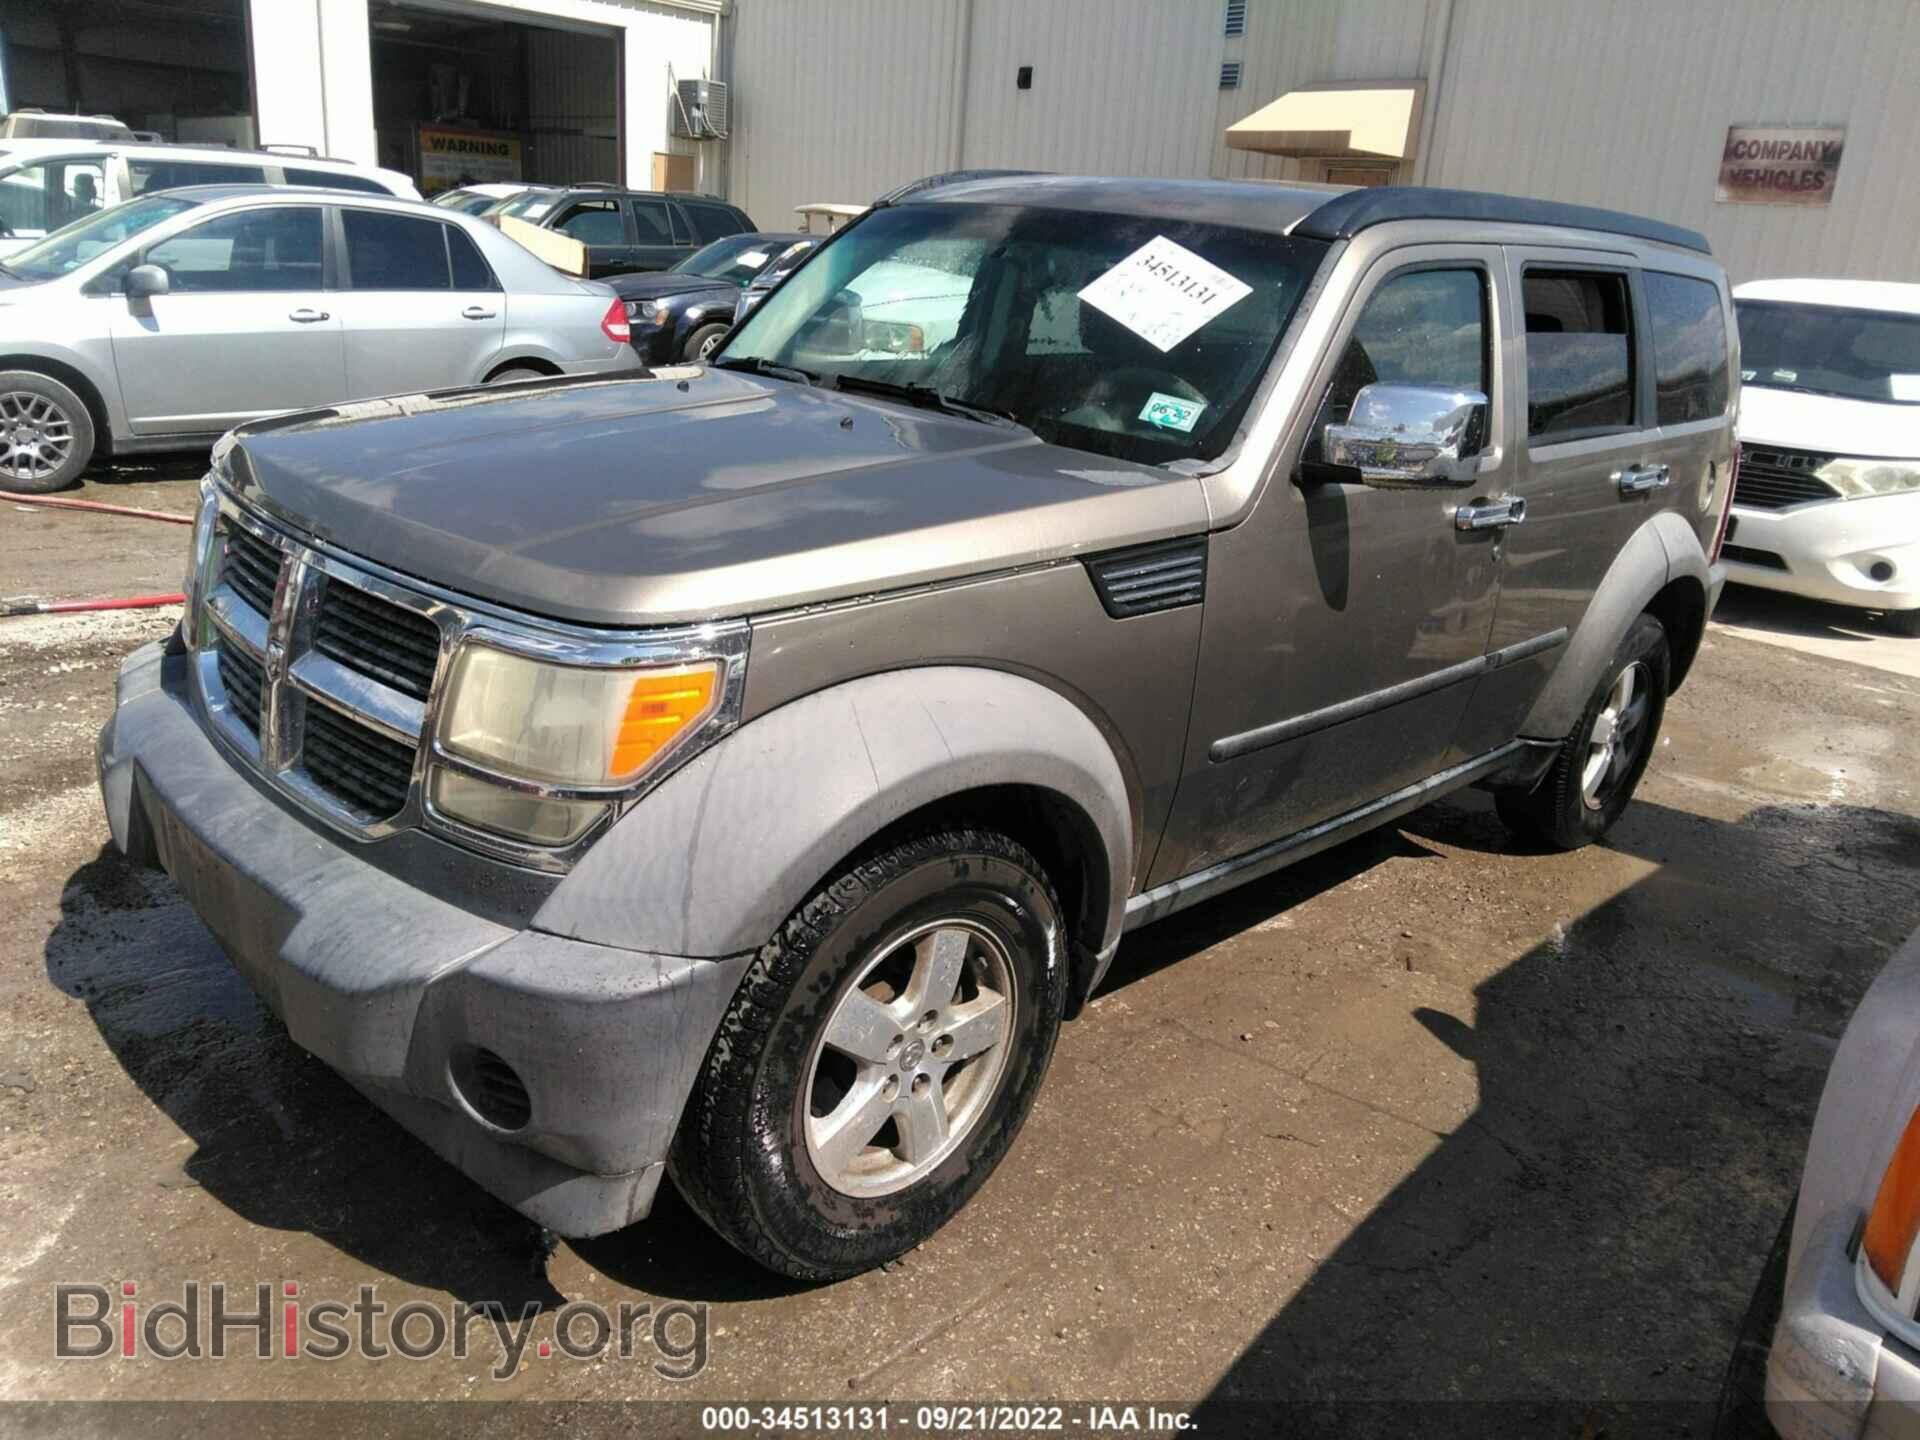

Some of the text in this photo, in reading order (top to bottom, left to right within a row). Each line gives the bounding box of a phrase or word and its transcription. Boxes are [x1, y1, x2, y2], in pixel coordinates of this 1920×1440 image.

[430, 136, 509, 155] WARNING
[1733, 139, 1834, 161] COMPANY
[1728, 168, 1825, 192] VEHICLES
[1136, 254, 1218, 305] 34513131
